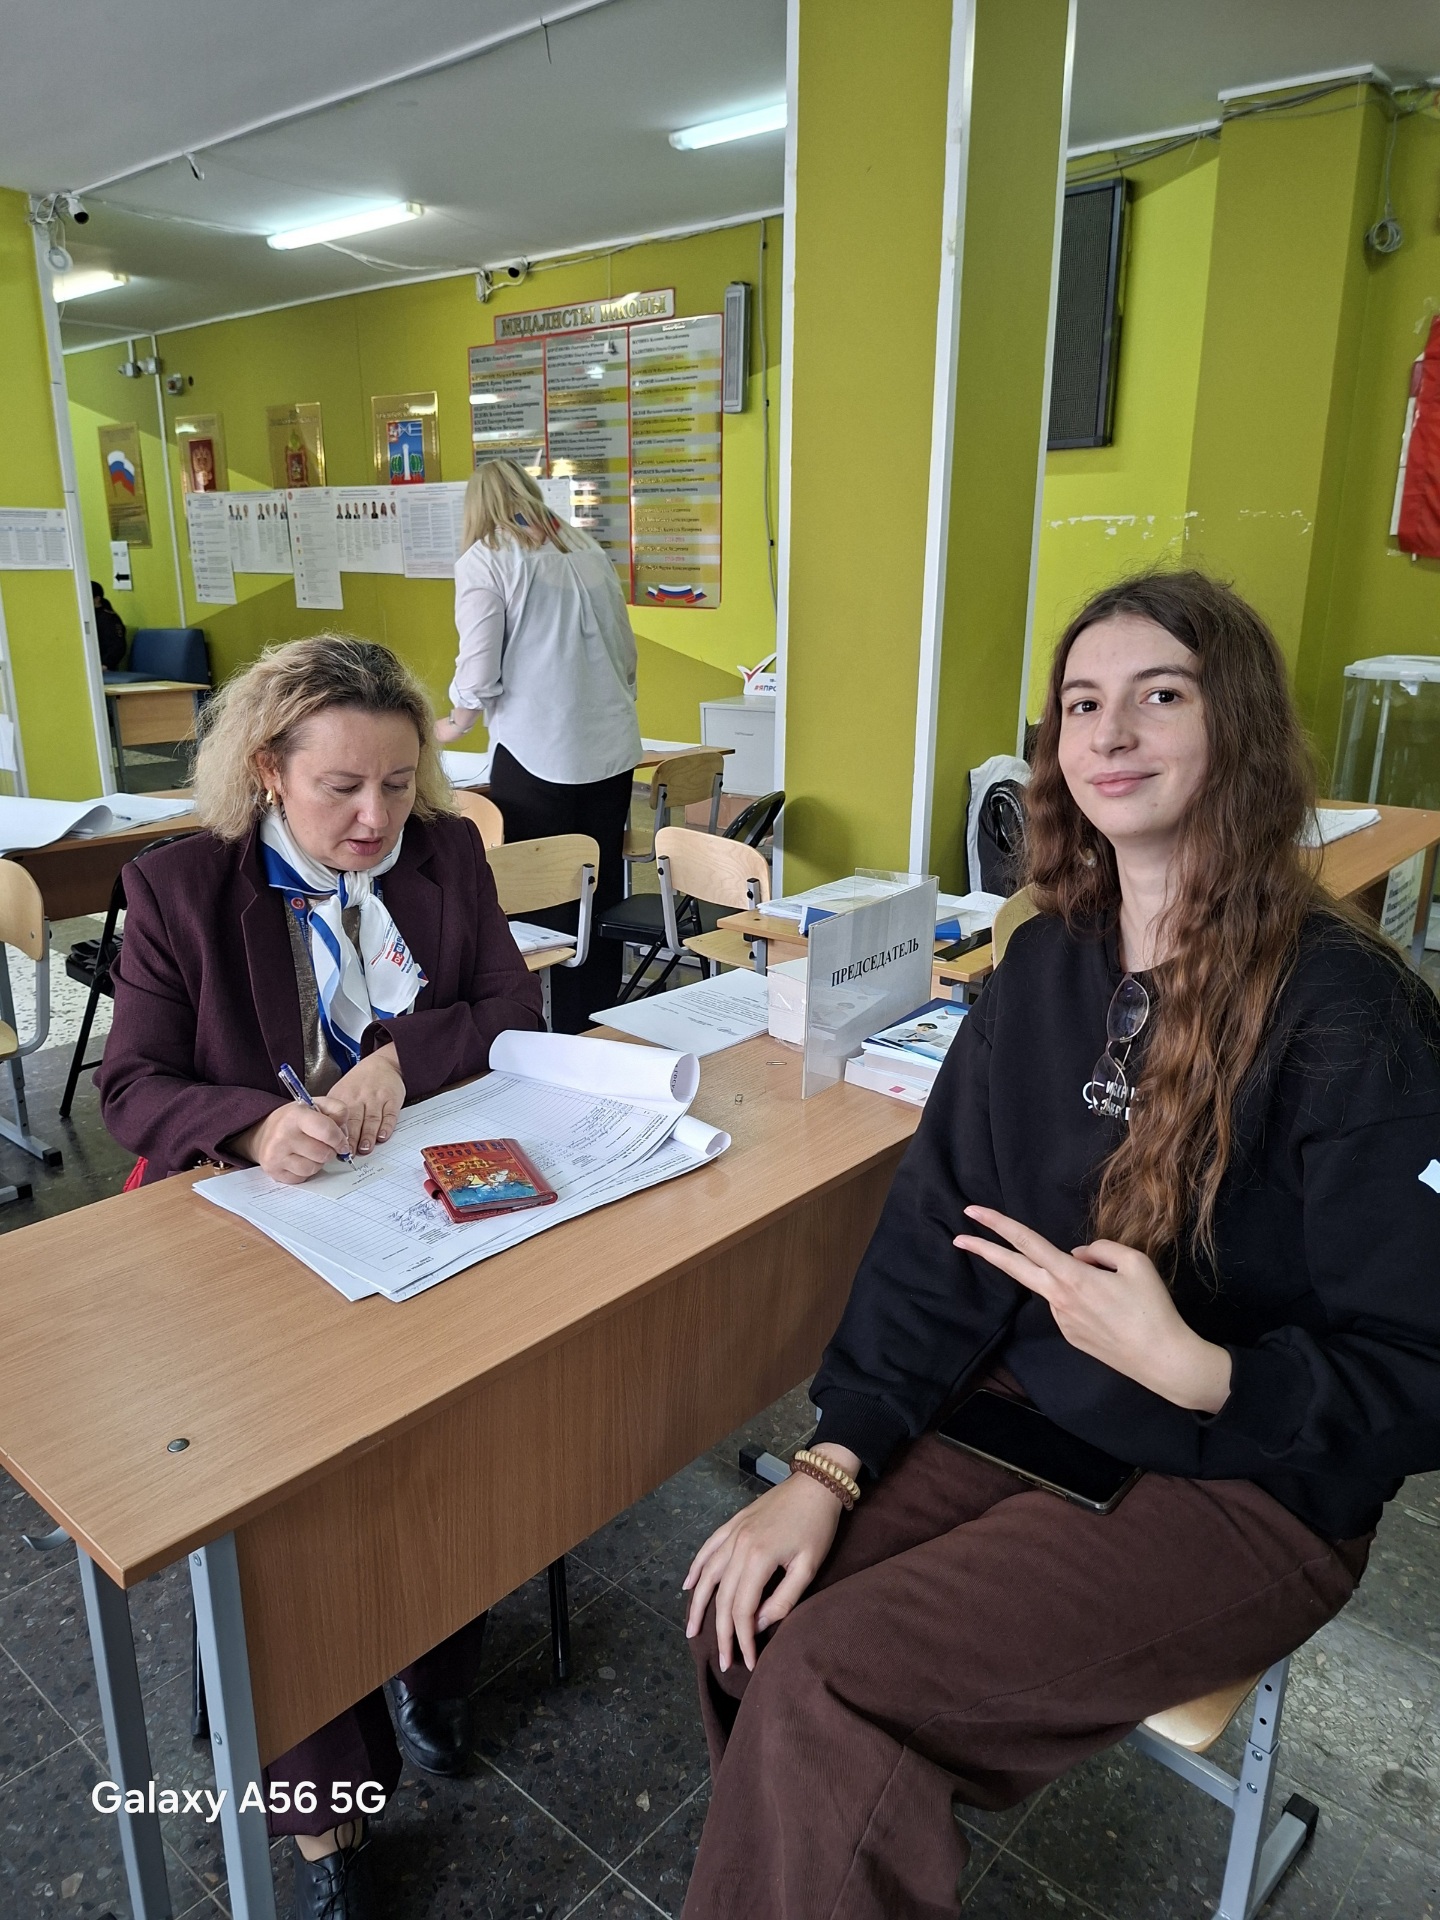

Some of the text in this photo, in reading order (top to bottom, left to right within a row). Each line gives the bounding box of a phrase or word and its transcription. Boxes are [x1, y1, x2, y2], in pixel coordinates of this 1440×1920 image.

[501, 294, 667, 338] МЕДАЛИСТЫ ШКОЛЫ
[831, 938, 919, 987] ПРЕДСЕДАТЕЛЬ
